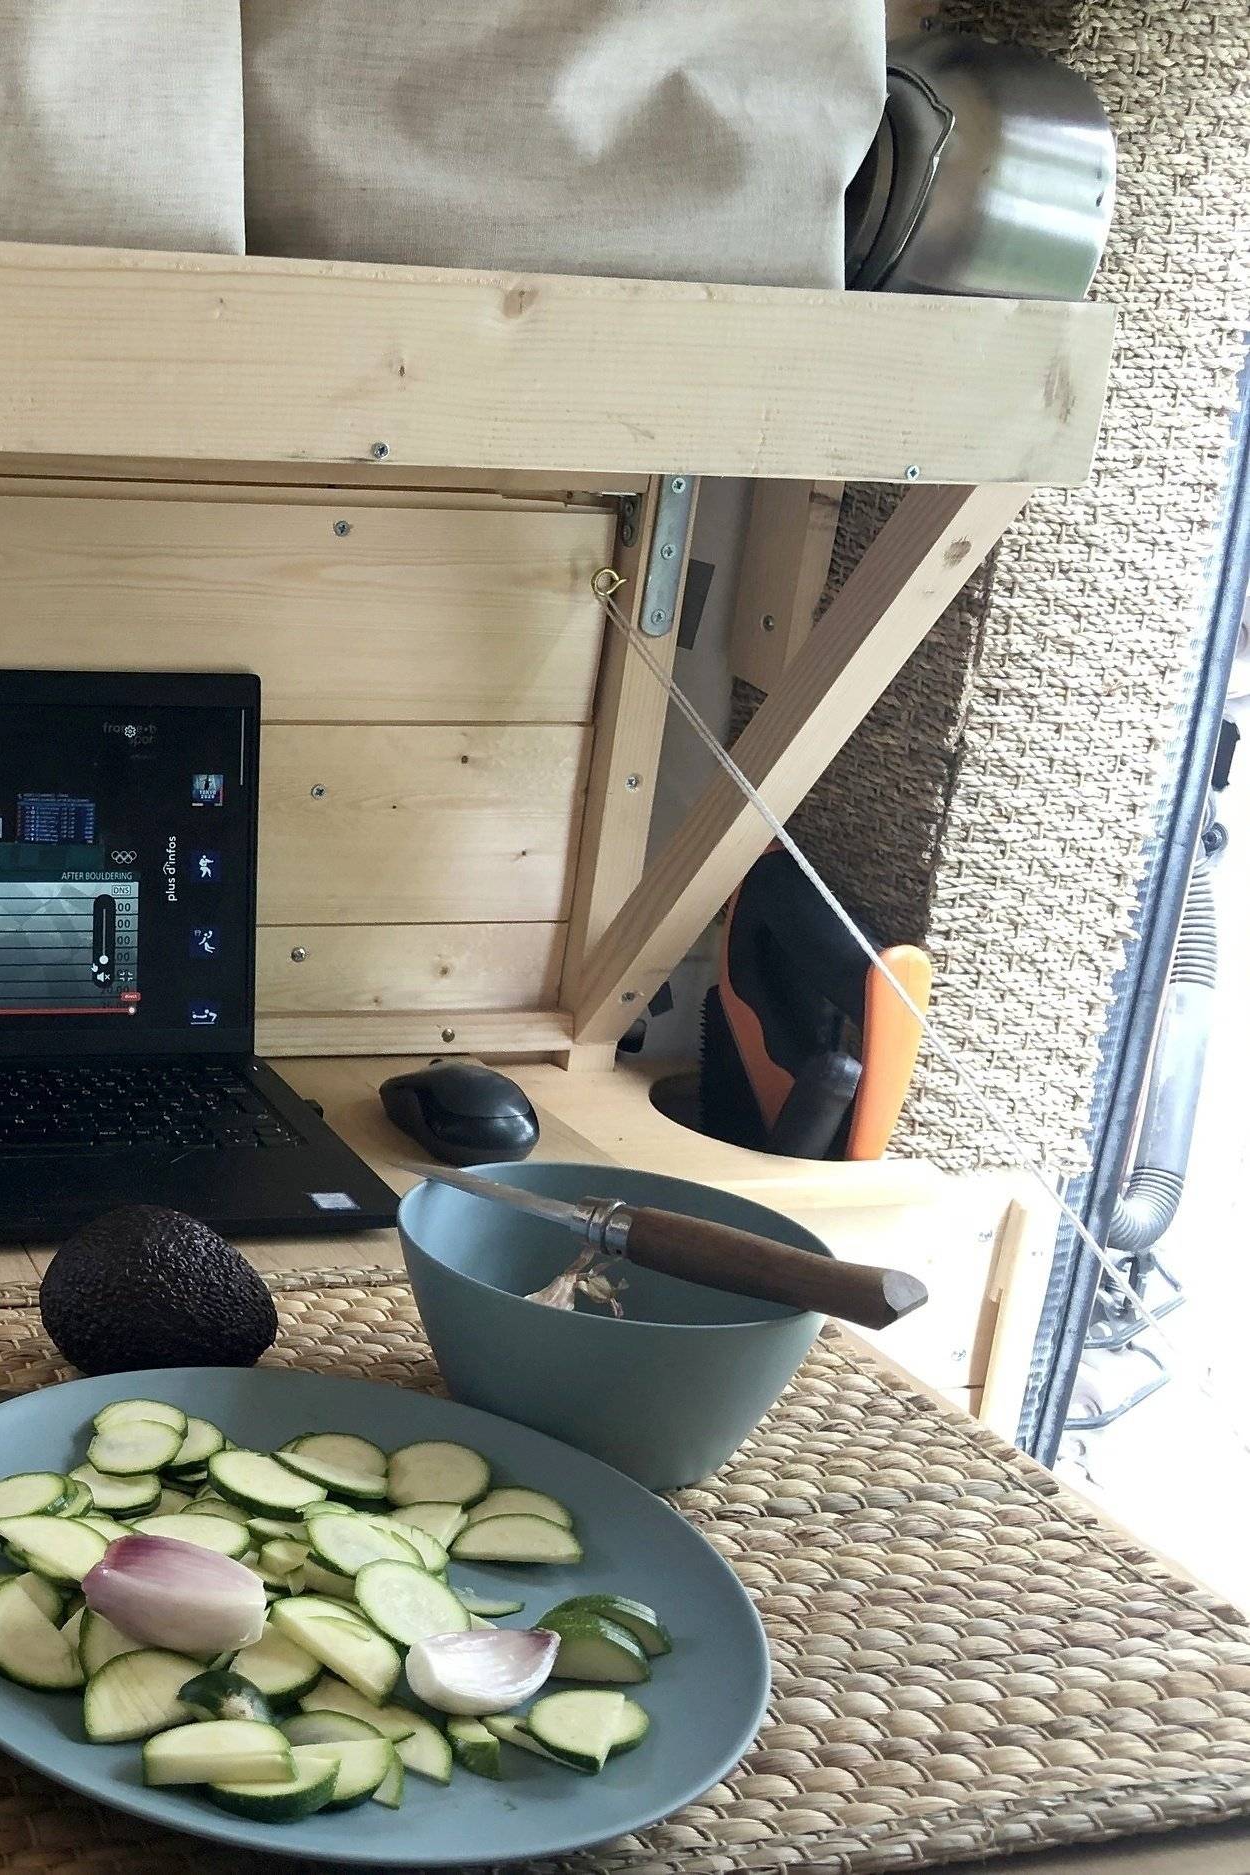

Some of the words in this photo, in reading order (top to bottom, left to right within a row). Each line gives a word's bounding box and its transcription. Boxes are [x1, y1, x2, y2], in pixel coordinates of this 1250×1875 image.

[166, 836, 176, 874] d'infos
[62, 872, 84, 880] AFTER
[85, 872, 133, 880] BOULDERING
[166, 877, 178, 902] plus
